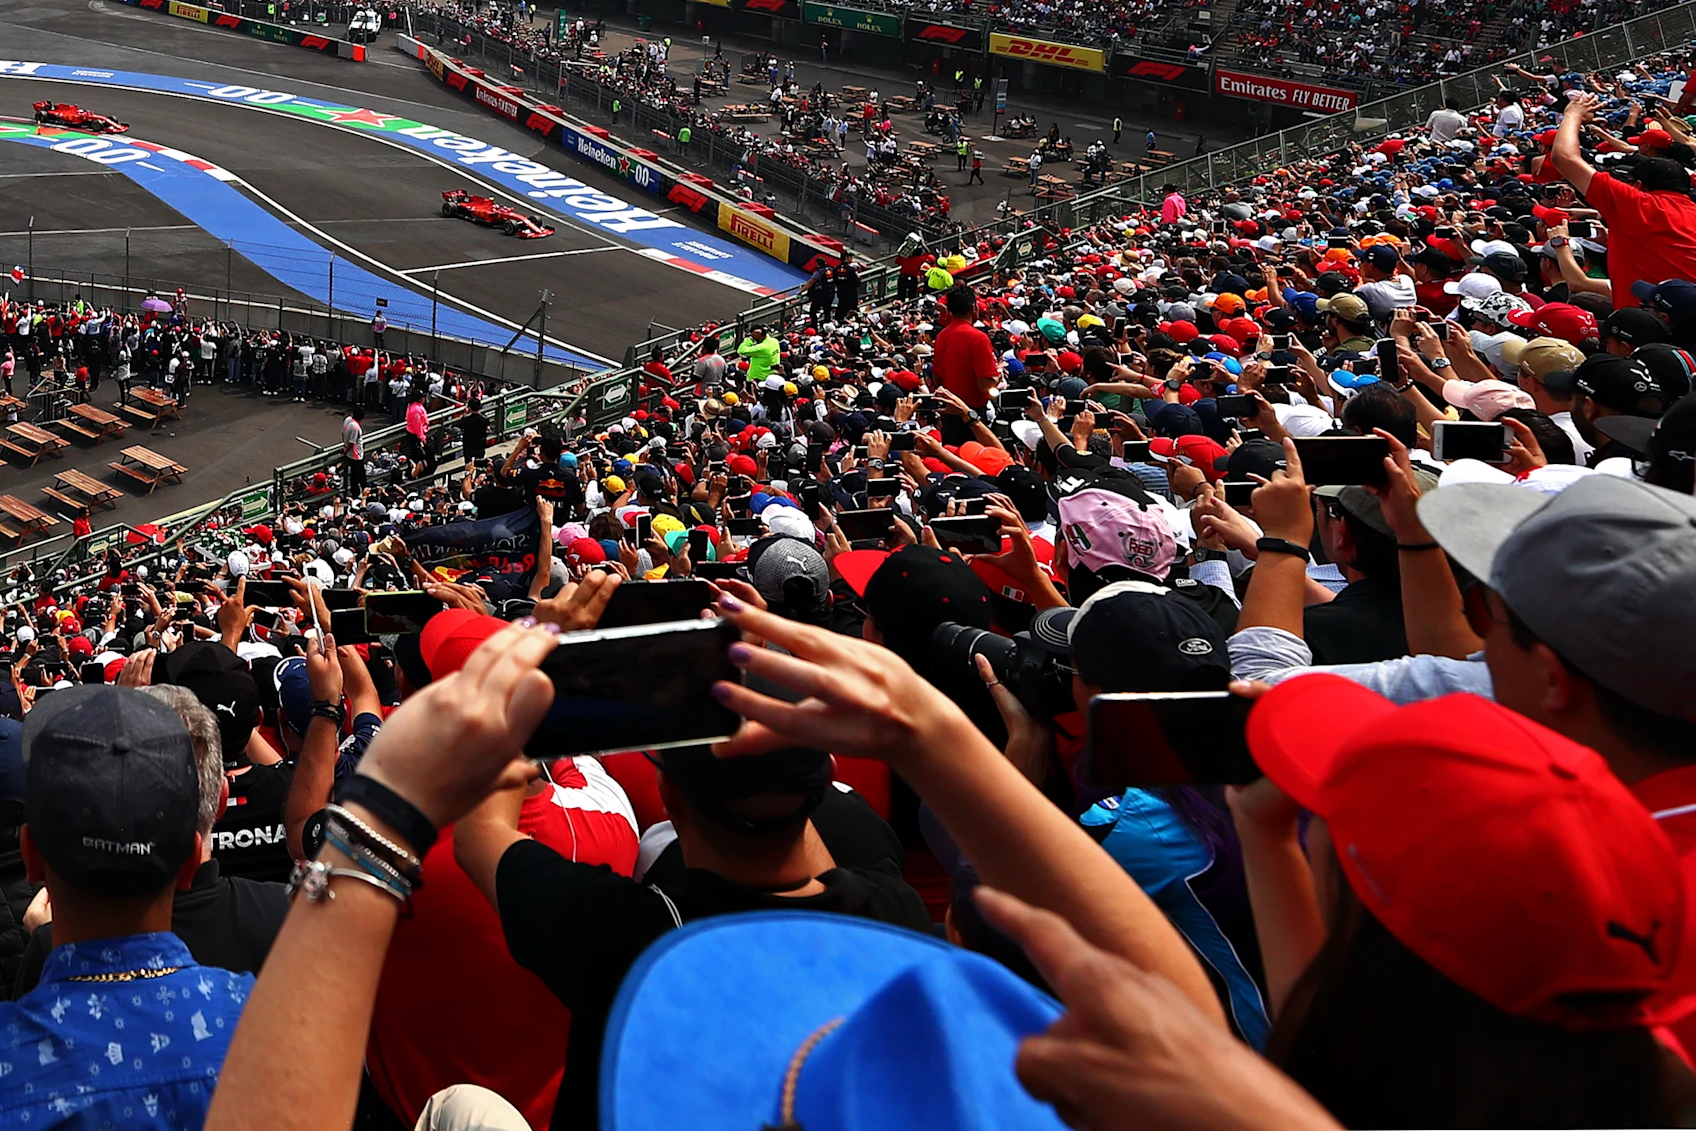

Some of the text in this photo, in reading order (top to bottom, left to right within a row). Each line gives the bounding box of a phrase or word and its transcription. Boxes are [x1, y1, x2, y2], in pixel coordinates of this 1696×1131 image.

[177, 5, 200, 19] PIRELLI
[818, 16, 882, 32] ROLEX ROLEX
[1006, 40, 1078, 65] DHL
[476, 86, 498, 108] Emirates
[505, 101, 518, 118] BETTER
[1220, 76, 1350, 112] Emirates FLY BETTER
[578, 136, 616, 170] Heineken
[397, 124, 686, 234] Heineken
[730, 212, 774, 250] PIRELLI
[1128, 538, 1152, 557] RED
[82, 836, 152, 856] BATMAN
